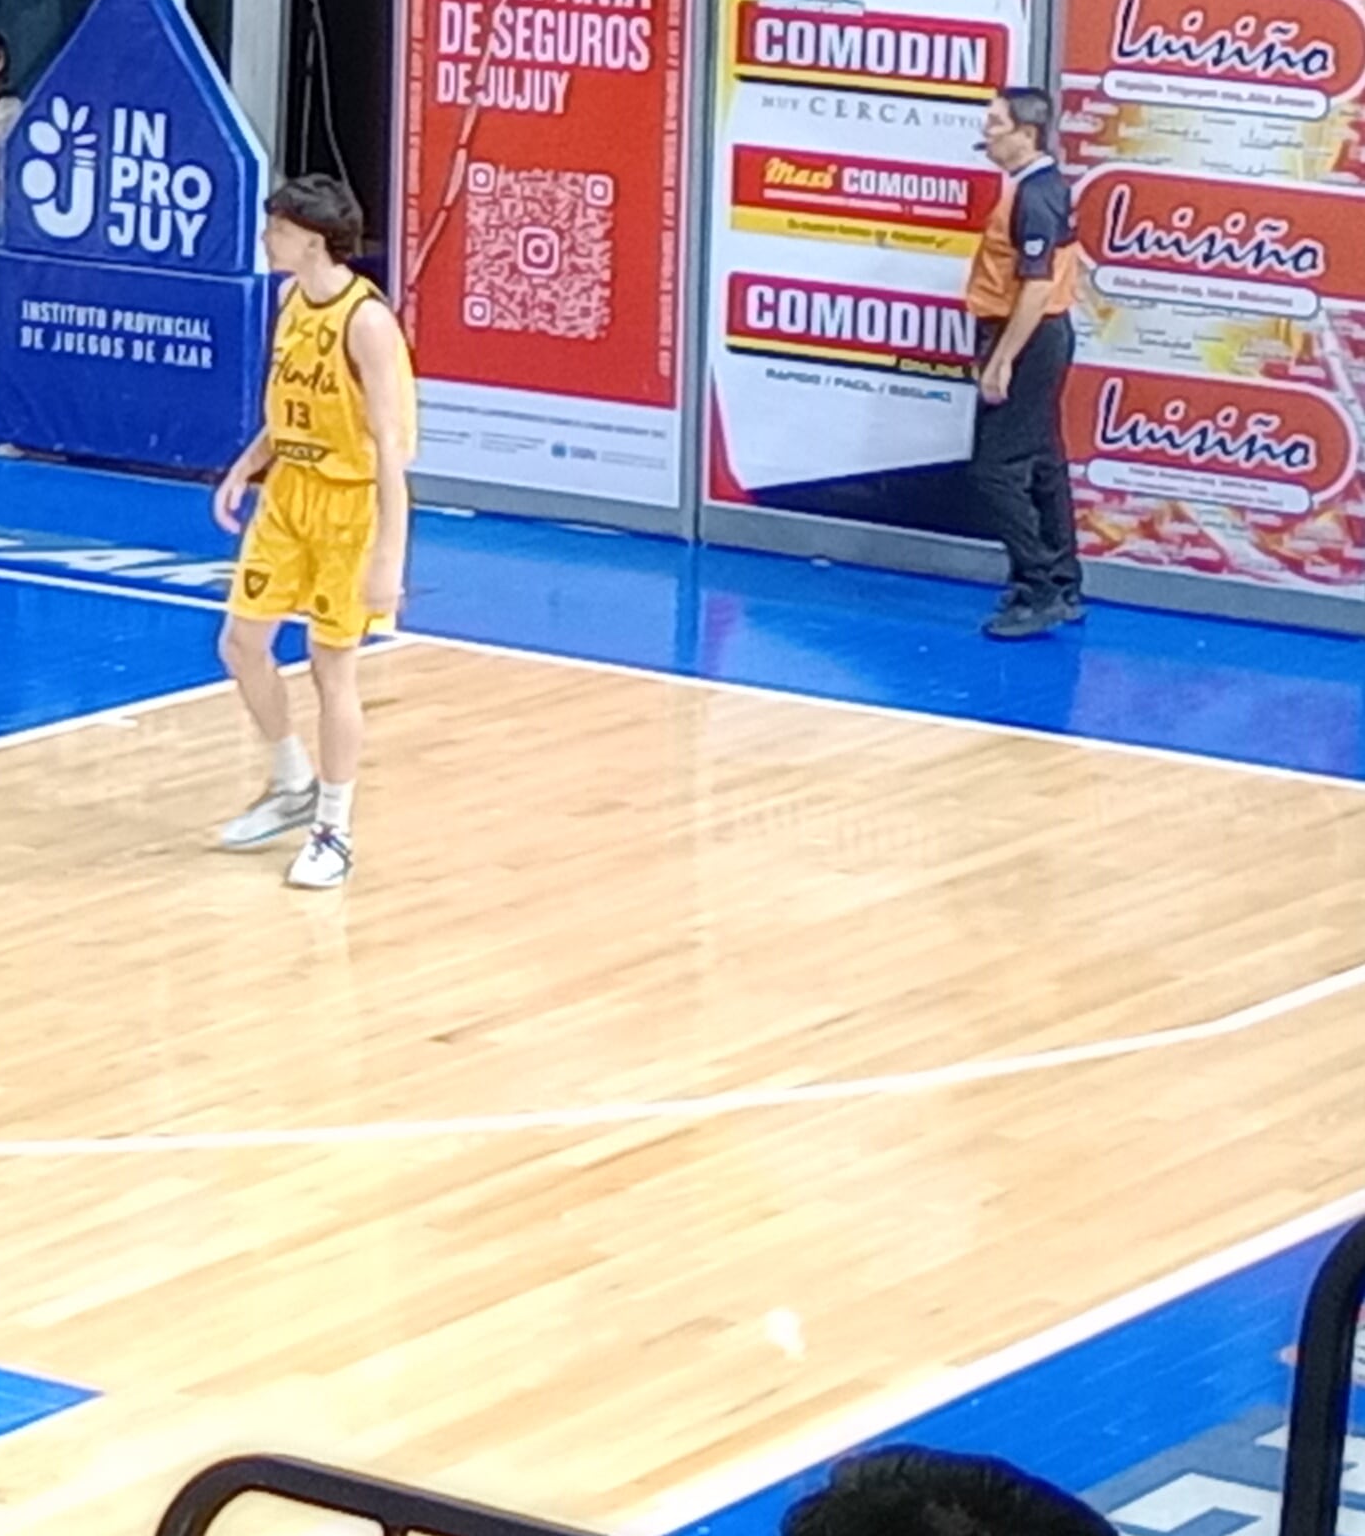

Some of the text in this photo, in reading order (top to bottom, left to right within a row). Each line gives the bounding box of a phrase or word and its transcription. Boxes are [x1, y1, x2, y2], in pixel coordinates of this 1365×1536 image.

[438, 0, 653, 72] DE SEGUROS
[753, 16, 988, 83] COMODIN
[436, 60, 571, 115] DE JUJUY
[808, 96, 922, 126] CERCA
[112, 107, 167, 159] IN
[110, 156, 213, 212] PRO
[841, 167, 970, 206] COMODIN
[106, 201, 208, 258] JUY
[1107, 188, 1322, 275] Luisiño
[21, 299, 212, 343] INSTITUTO PROVINCIAL
[745, 283, 976, 356] COMODIN
[20, 326, 213, 369] DE JUEGOS DE AZAR
[284, 398, 312, 431] 13
[1099, 381, 1312, 469] Luisiño
